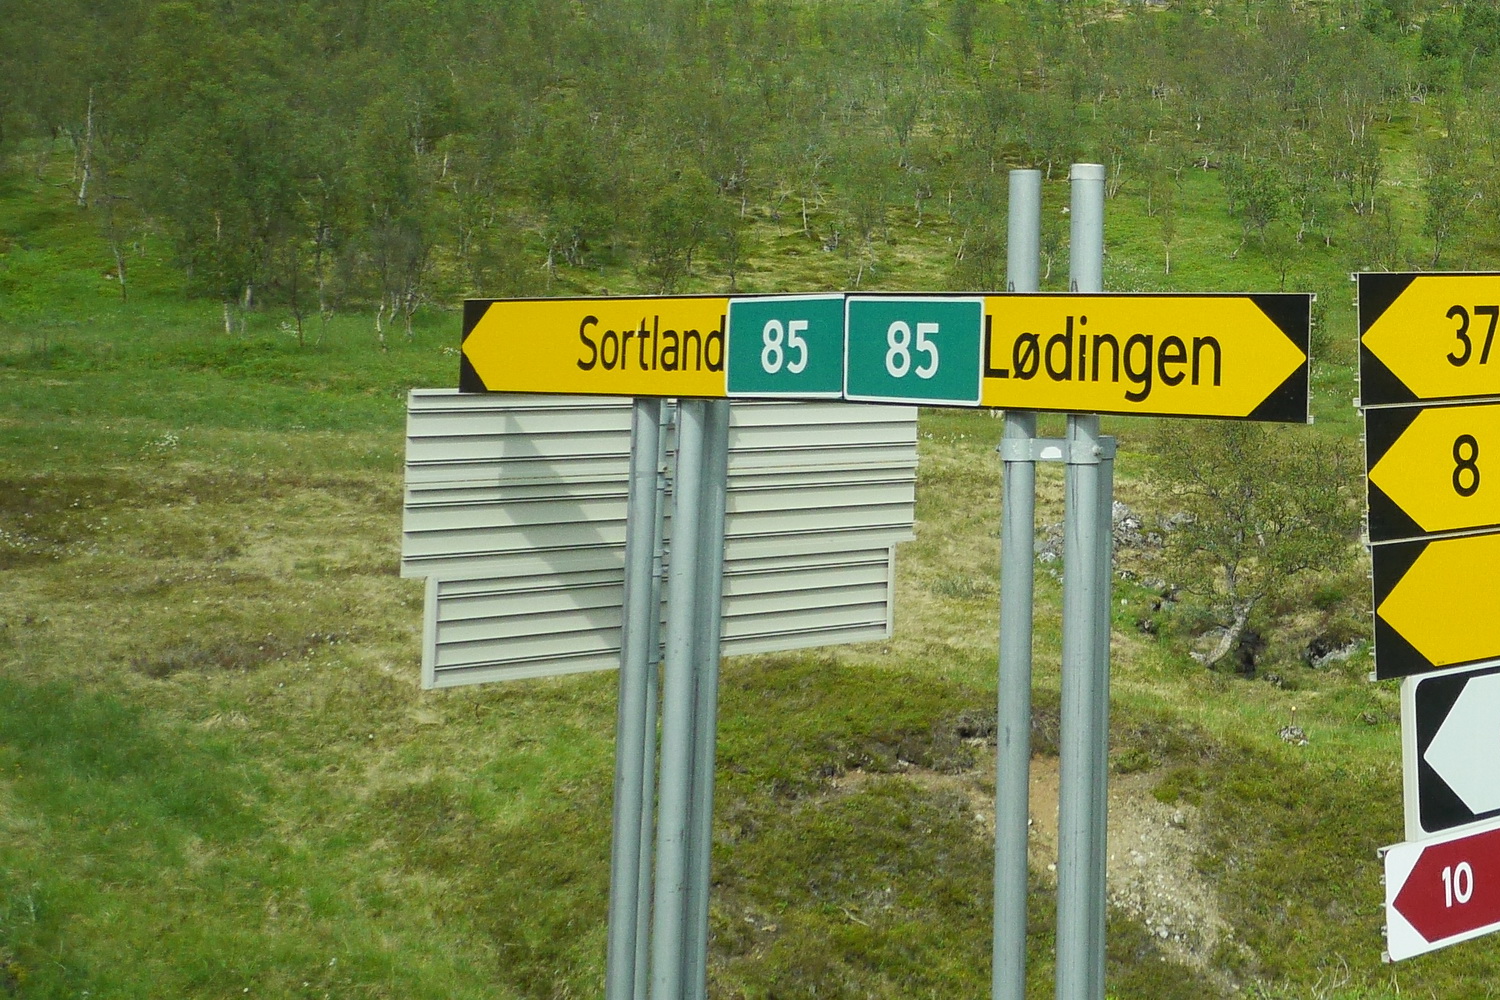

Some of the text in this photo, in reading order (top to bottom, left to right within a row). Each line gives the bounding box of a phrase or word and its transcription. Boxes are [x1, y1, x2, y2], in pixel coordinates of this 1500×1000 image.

[577, 314, 809, 375] Sortland 85
[885, 314, 1222, 403] 85 Lødingen
[1445, 305, 1500, 368] 37
[1451, 433, 1481, 497] 8
[1441, 861, 1474, 908] 10
